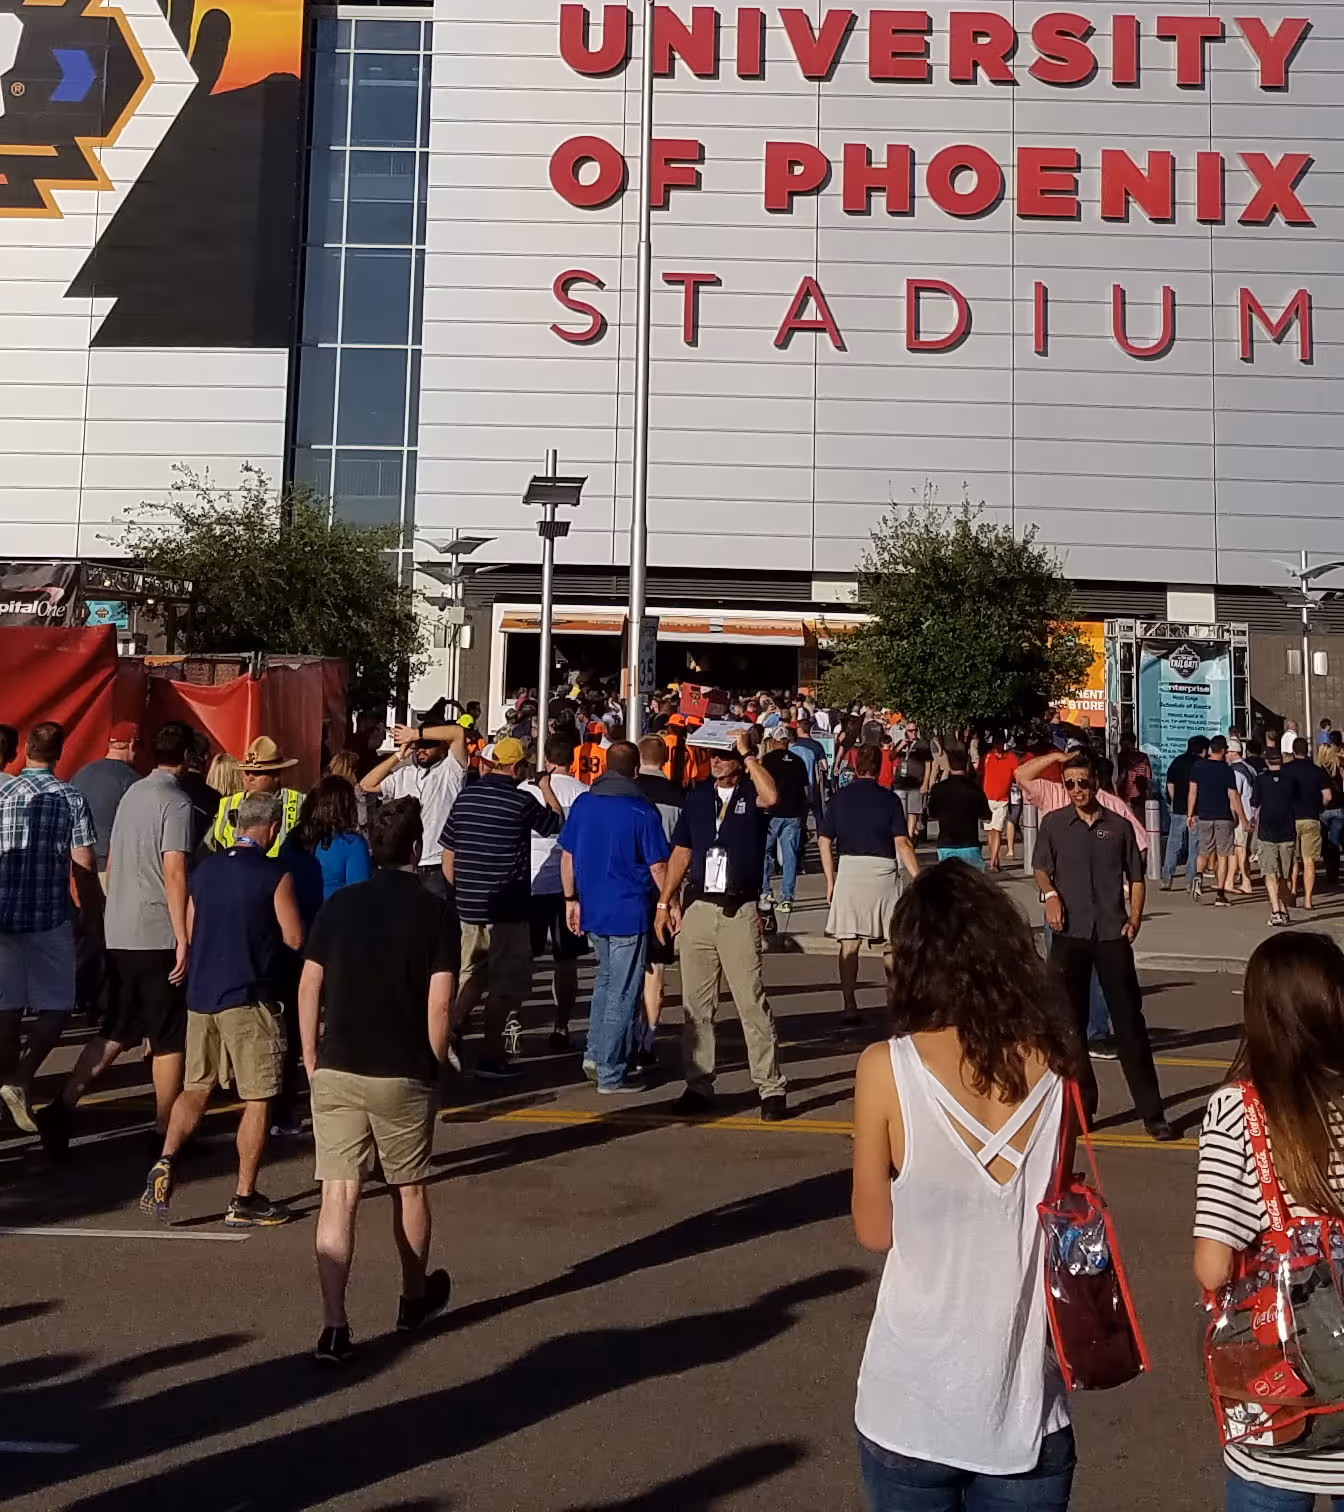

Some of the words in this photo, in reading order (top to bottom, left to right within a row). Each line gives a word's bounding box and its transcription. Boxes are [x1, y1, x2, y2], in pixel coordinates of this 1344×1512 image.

[558, 2, 1313, 90] UNIVERSITY
[549, 135, 705, 208] OF
[764, 140, 1317, 228] PHOENIX
[549, 268, 1316, 365] STADIUM
[1068, 699, 1105, 711] STORE
